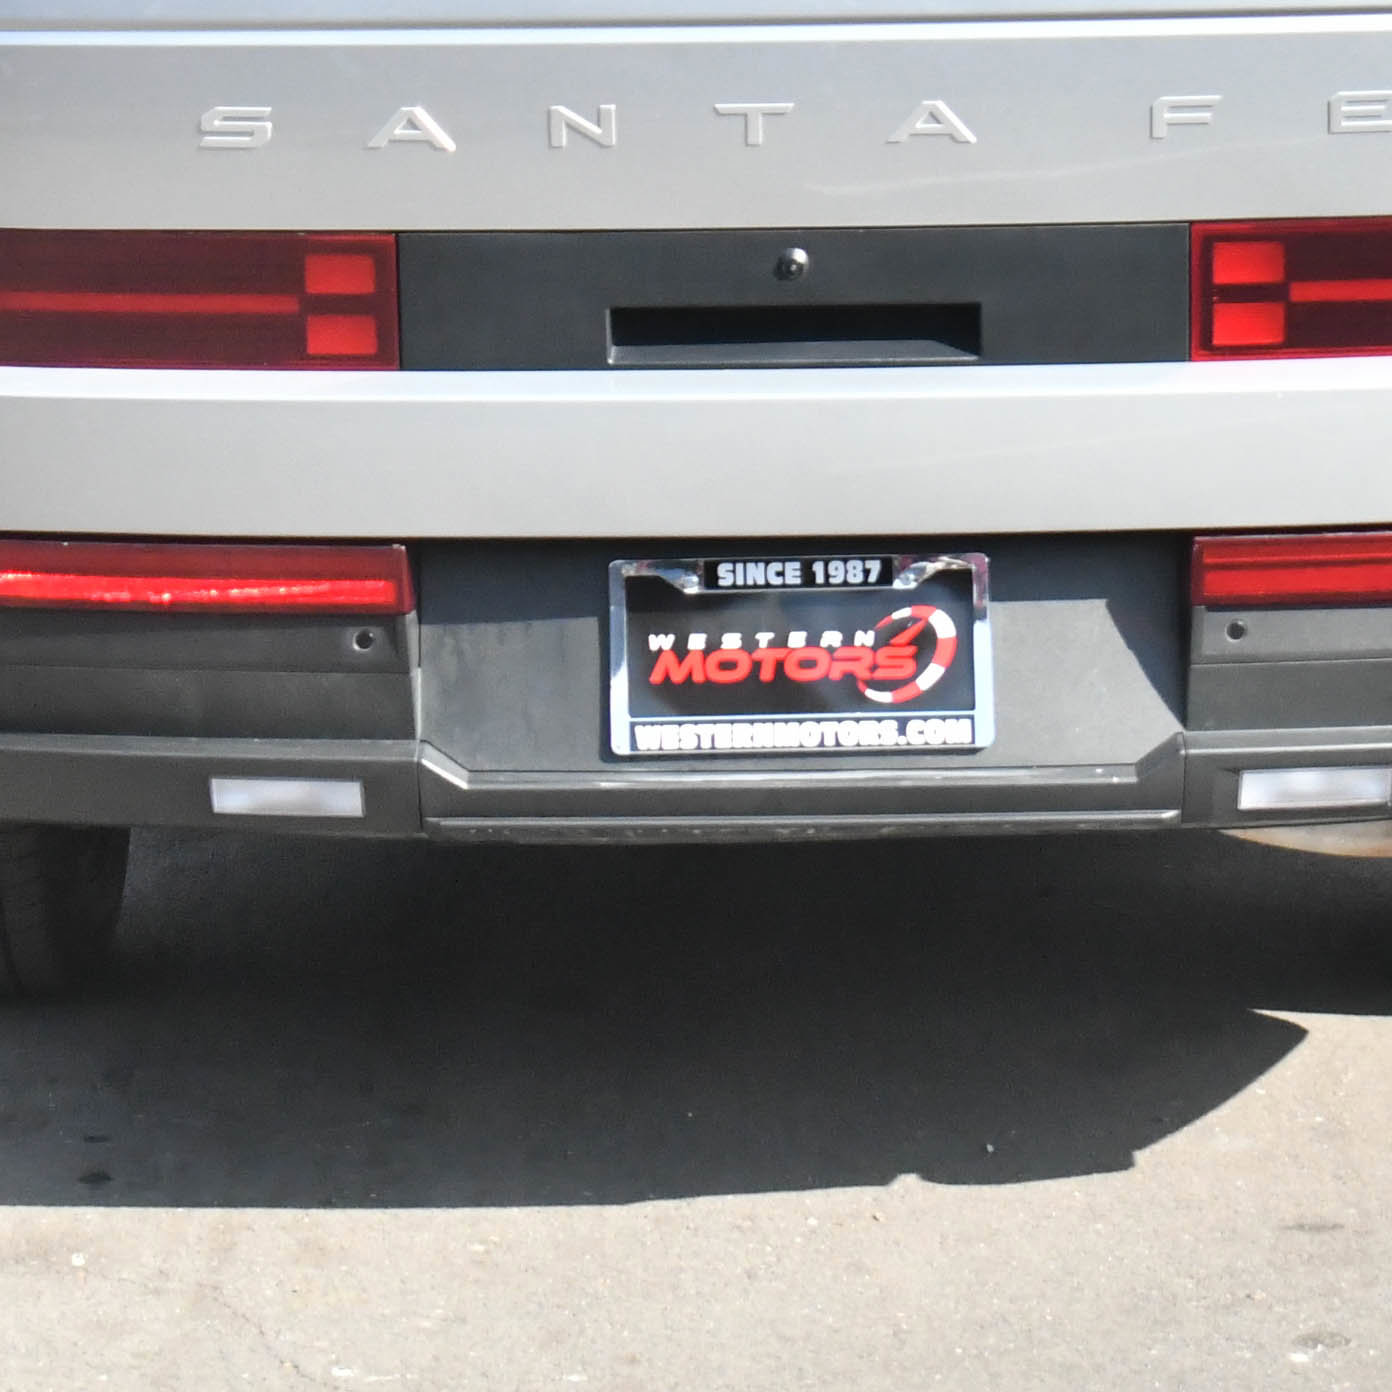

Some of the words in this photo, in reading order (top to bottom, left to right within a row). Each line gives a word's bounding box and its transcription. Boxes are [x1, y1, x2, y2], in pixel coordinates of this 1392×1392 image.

[197, 99, 977, 152] SANTA
[716, 562, 802, 587] SINCE
[811, 559, 883, 585] 1987
[648, 629, 877, 651] WESTERN
[649, 645, 918, 685] MOTORS
[634, 719, 972, 751] WESTERNMOTORS.COM
